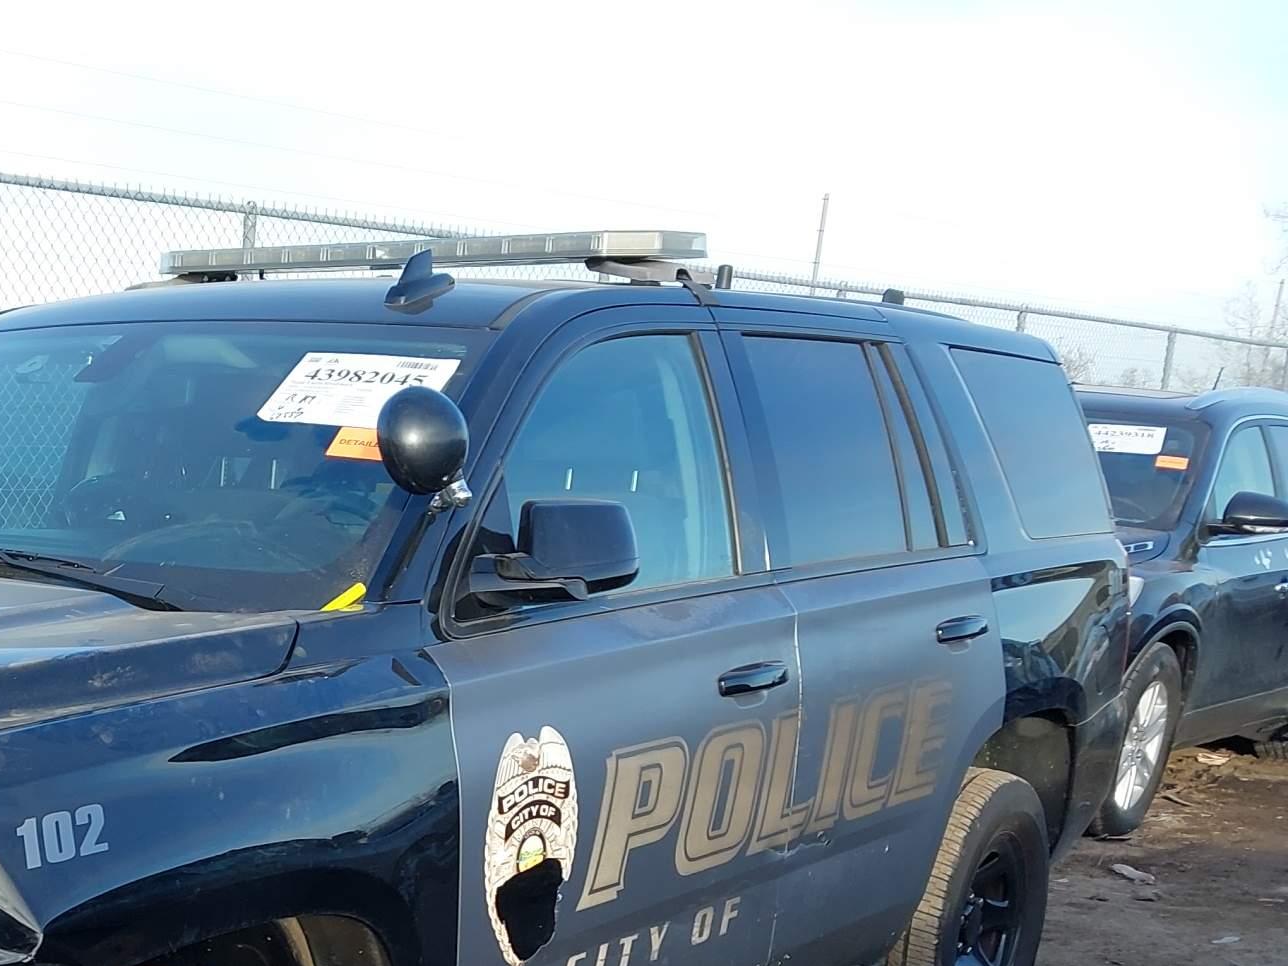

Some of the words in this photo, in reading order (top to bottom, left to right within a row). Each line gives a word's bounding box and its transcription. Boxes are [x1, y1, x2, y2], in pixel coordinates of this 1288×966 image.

[304, 367, 429, 386] 43982045
[502, 778, 567, 813] POLICE
[576, 676, 953, 912] POLICE
[16, 803, 109, 870] 102
[511, 804, 539, 830] CITY
[539, 804, 556, 818] OF
[691, 896, 741, 947] OF
